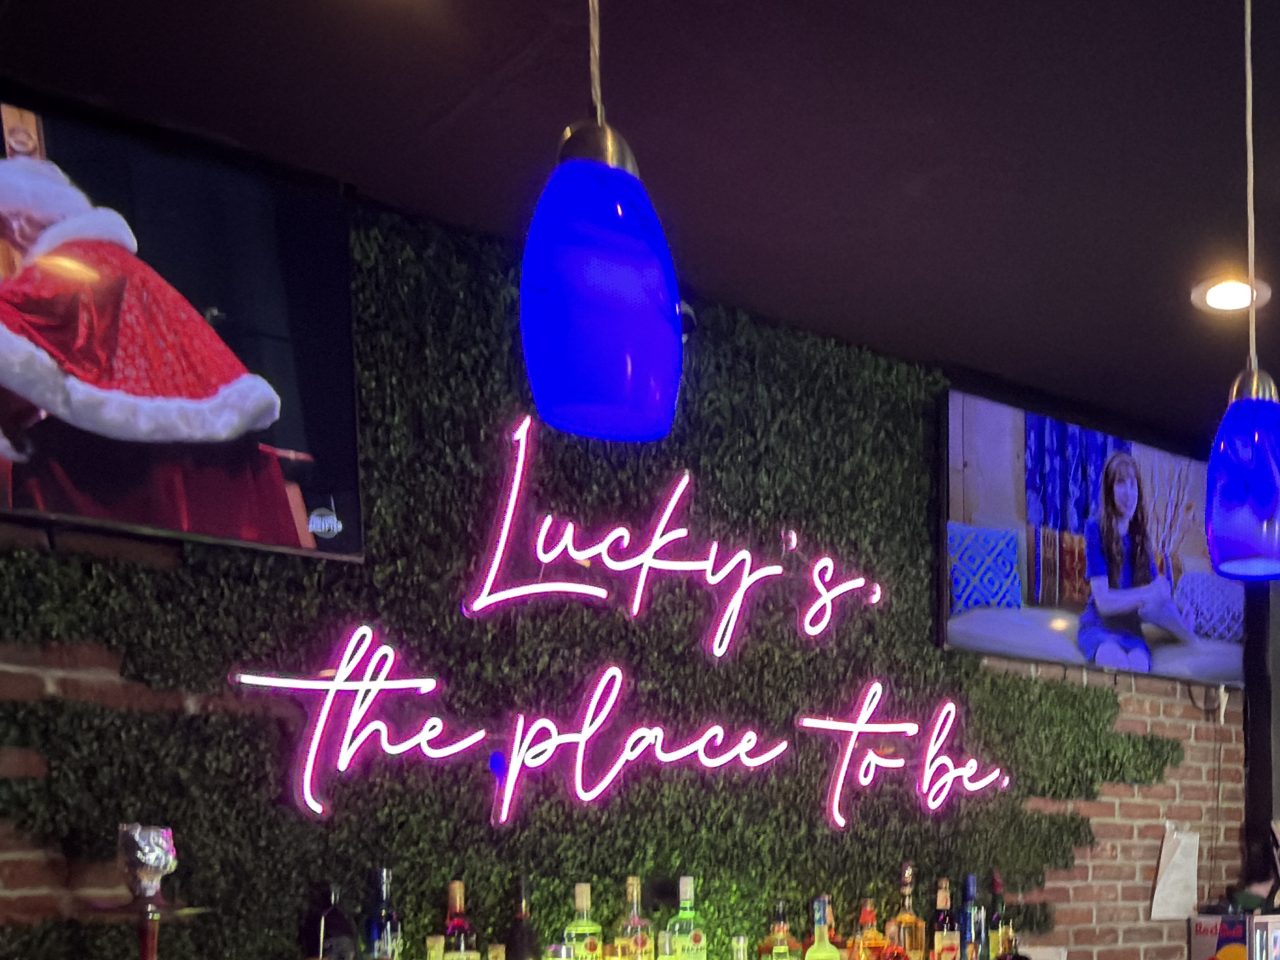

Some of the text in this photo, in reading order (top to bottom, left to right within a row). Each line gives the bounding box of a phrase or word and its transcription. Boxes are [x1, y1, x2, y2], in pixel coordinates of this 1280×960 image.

[237, 625, 486, 815] the
[497, 666, 788, 824] place
[799, 682, 919, 828] to
[1195, 921, 1219, 936] Red
